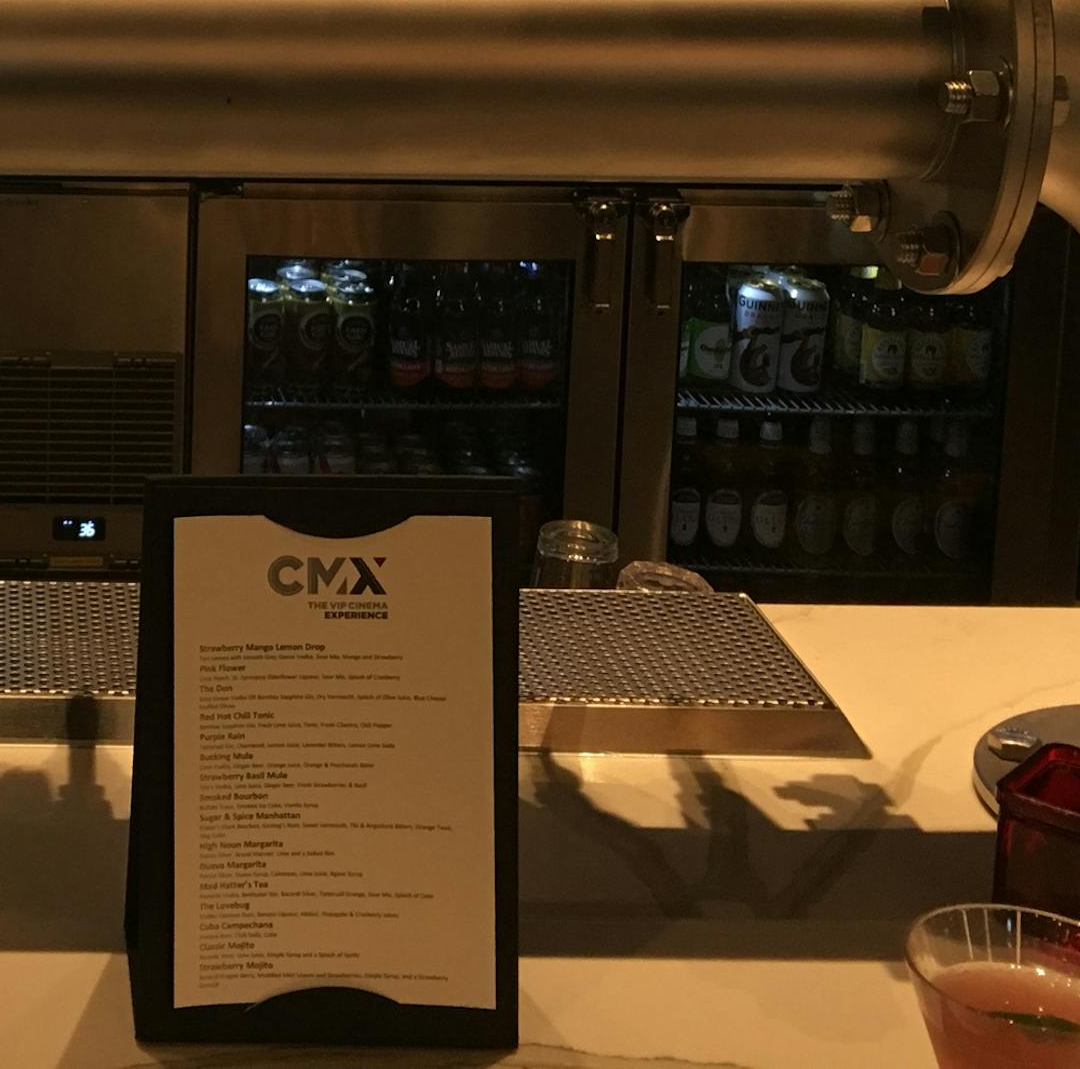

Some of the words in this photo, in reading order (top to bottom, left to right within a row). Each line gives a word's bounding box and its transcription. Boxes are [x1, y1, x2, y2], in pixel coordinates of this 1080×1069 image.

[77, 519, 96, 538] 36
[267, 555, 387, 596] CMX
[308, 602, 328, 610] THE
[330, 602, 347, 610] VIP
[348, 602, 388, 610] CINEMA
[324, 611, 389, 620] EXPERIENCE
[200, 644, 243, 653] Strawberry
[246, 643, 274, 652] Mango
[276, 643, 303, 651] Lemon
[305, 643, 326, 652] Drop
[219, 663, 246, 671] Flower
[253, 711, 275, 719] Tonic
[200, 733, 225, 741] Purple
[228, 732, 245, 740] Rain
[233, 752, 254, 760] Mule
[200, 772, 244, 781] Strawberry
[267, 771, 288, 779] Mule
[233, 792, 269, 800] Bourbon
[256, 812, 301, 820] Manhattan
[243, 840, 284, 849] Margarita
[227, 861, 267, 870] Margarita
[228, 941, 256, 950] Mojito
[246, 961, 274, 971] Mojito
